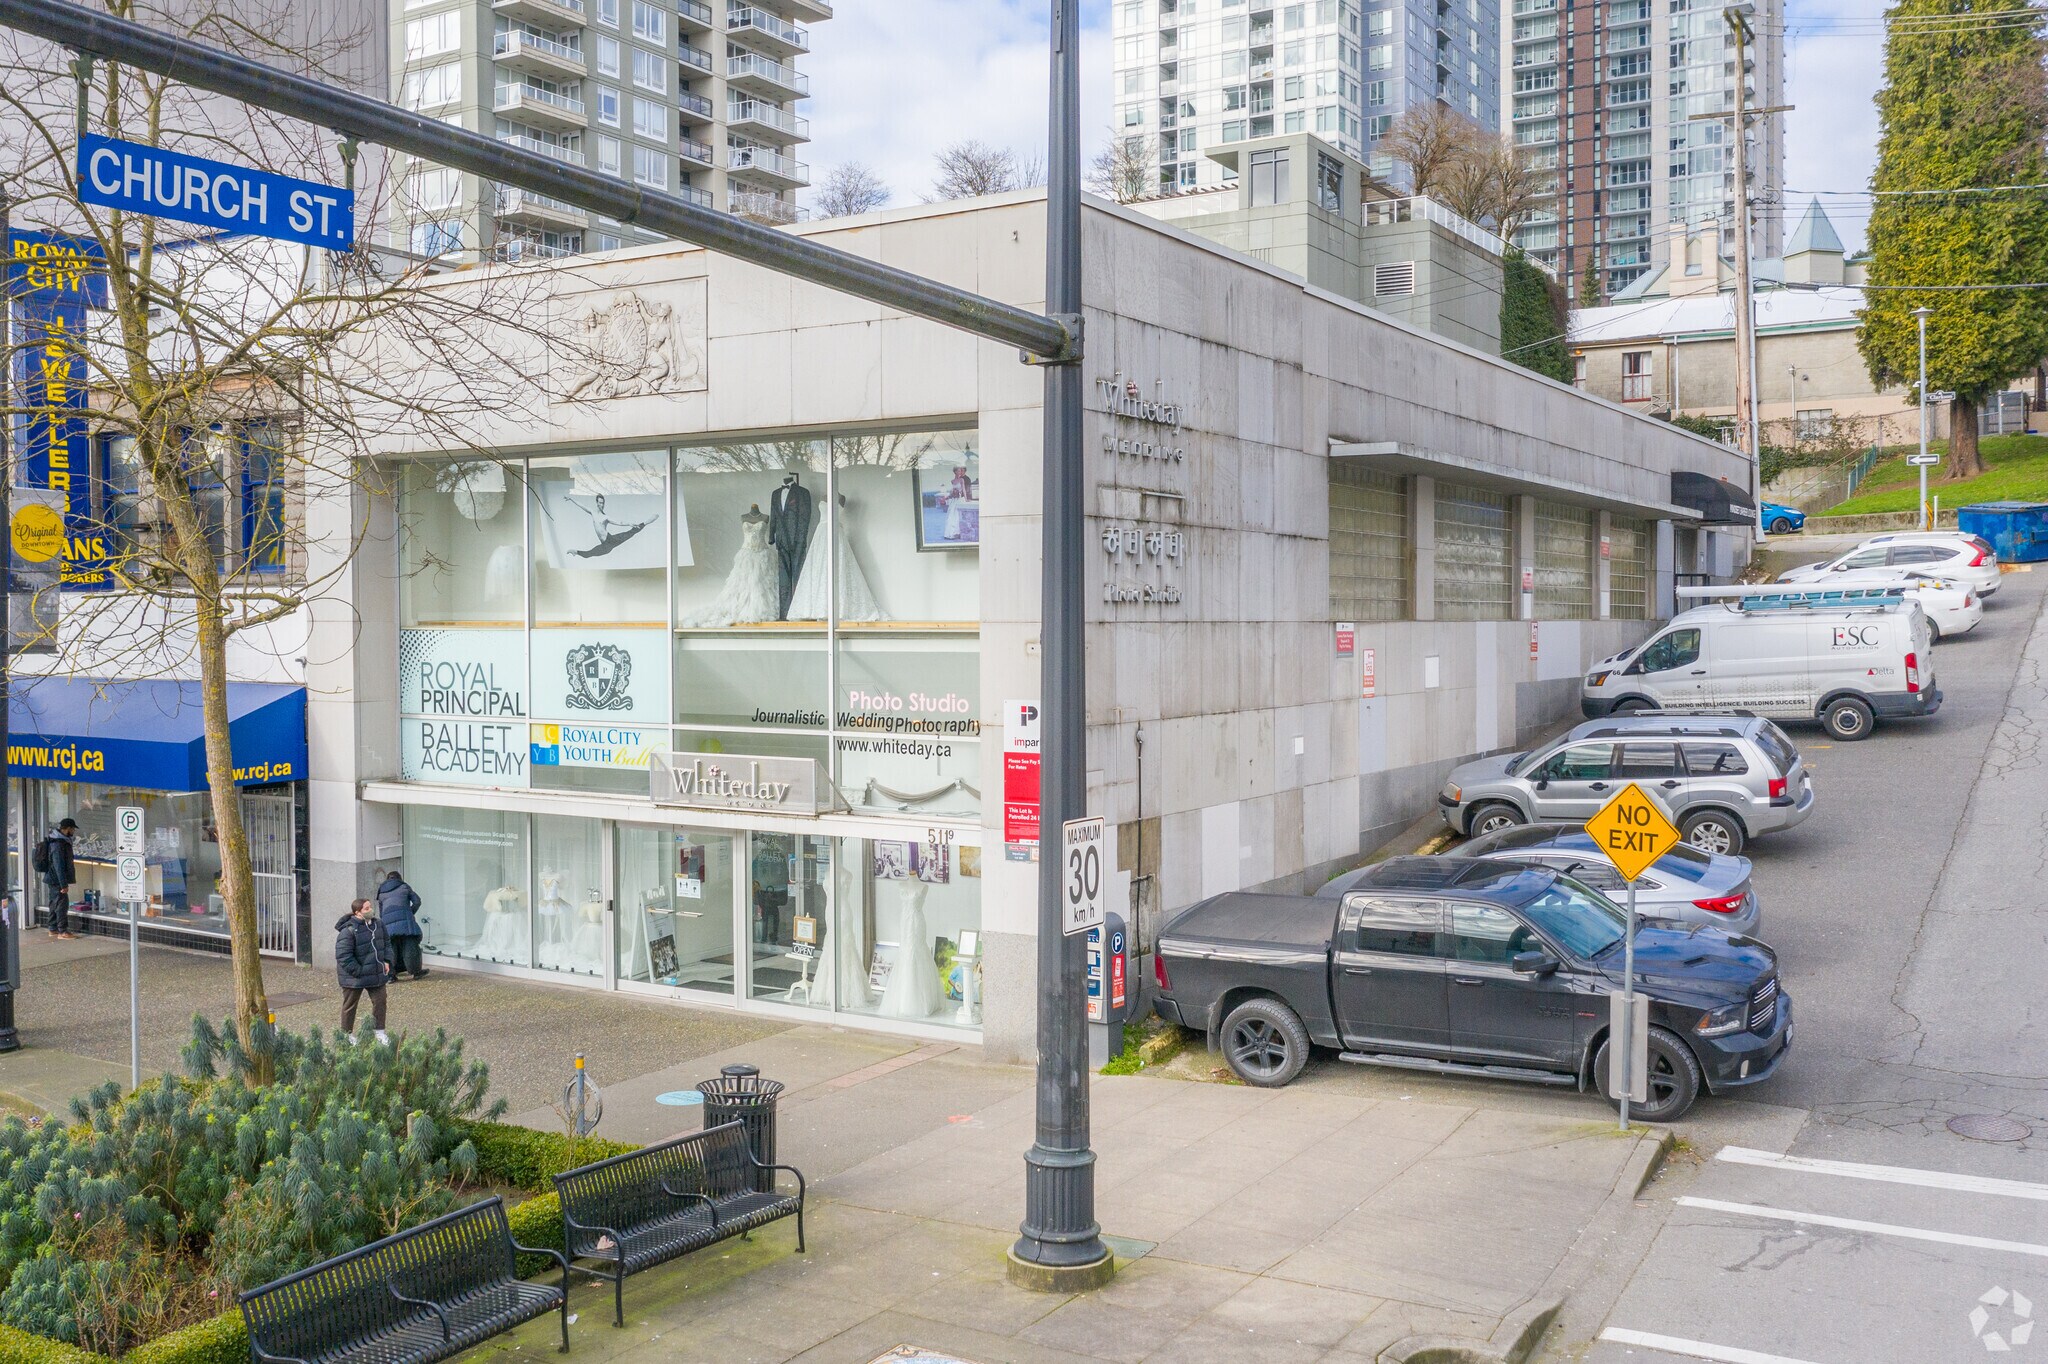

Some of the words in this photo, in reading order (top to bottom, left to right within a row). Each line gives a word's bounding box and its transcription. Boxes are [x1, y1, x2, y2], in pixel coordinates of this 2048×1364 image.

[89, 148, 268, 225] CHURCH
[288, 190, 344, 239] ST.
[27, 265, 80, 292] CITY
[1096, 371, 1185, 436] Whiteday
[1103, 437, 1184, 461] WEDDING
[15, 524, 58, 542] Original
[1104, 584, 1142, 603] Photo
[1144, 584, 1184, 603] Studio
[1831, 625, 1879, 646] ESC
[421, 661, 502, 691] ROYAL
[1868, 666, 1895, 676] Delta
[421, 690, 526, 716] PRINCIPAL
[850, 691, 902, 712] Photo
[909, 692, 970, 714] Studio
[751, 708, 825, 727] Journalistic
[837, 711, 894, 732] Wedding
[421, 722, 511, 754] BALLET
[562, 727, 605, 744] ROYAL
[606, 728, 641, 745] CITY
[7, 743, 104, 776] www.rcj.ca
[563, 744, 612, 762] YOUTH
[837, 738, 951, 760] www.whiteday.ca
[205, 761, 292, 783] w.rcj.ca
[420, 748, 526, 775] ACADEMY
[672, 758, 790, 804] Whiteday
[1617, 804, 1651, 827] NO
[1067, 824, 1100, 845] MAXIMUM
[1609, 829, 1659, 853] EXIT
[1069, 845, 1099, 905] 30
[1073, 903, 1095, 923] km/h
[793, 945, 813, 956] OPEN
